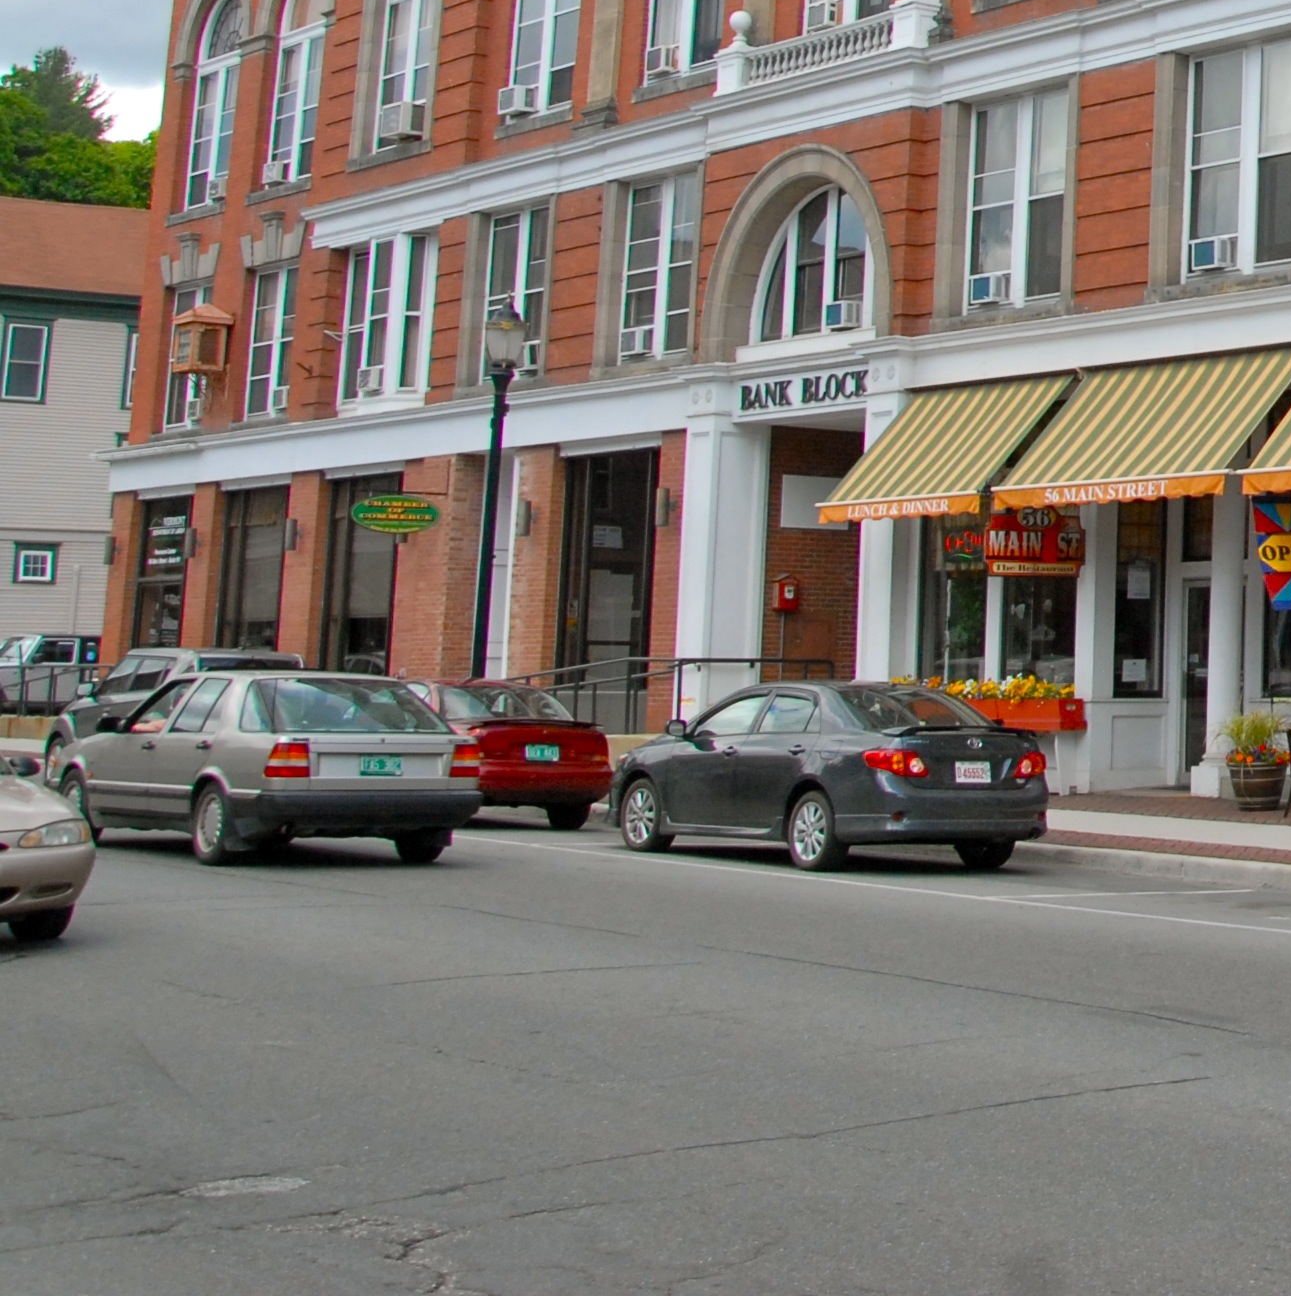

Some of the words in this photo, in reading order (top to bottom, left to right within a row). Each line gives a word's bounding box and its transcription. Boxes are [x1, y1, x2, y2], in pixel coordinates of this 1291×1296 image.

[740, 380, 793, 410] BANK
[801, 369, 869, 404] BLOCK
[1044, 488, 1060, 503] 56
[1062, 484, 1104, 502] MAIN
[1105, 480, 1169, 499] STREET
[847, 503, 888, 518] LUNCH
[889, 502, 900, 516] &
[902, 498, 950, 515] DINNER
[1021, 508, 1051, 527] 56
[988, 530, 1042, 557] MAIN
